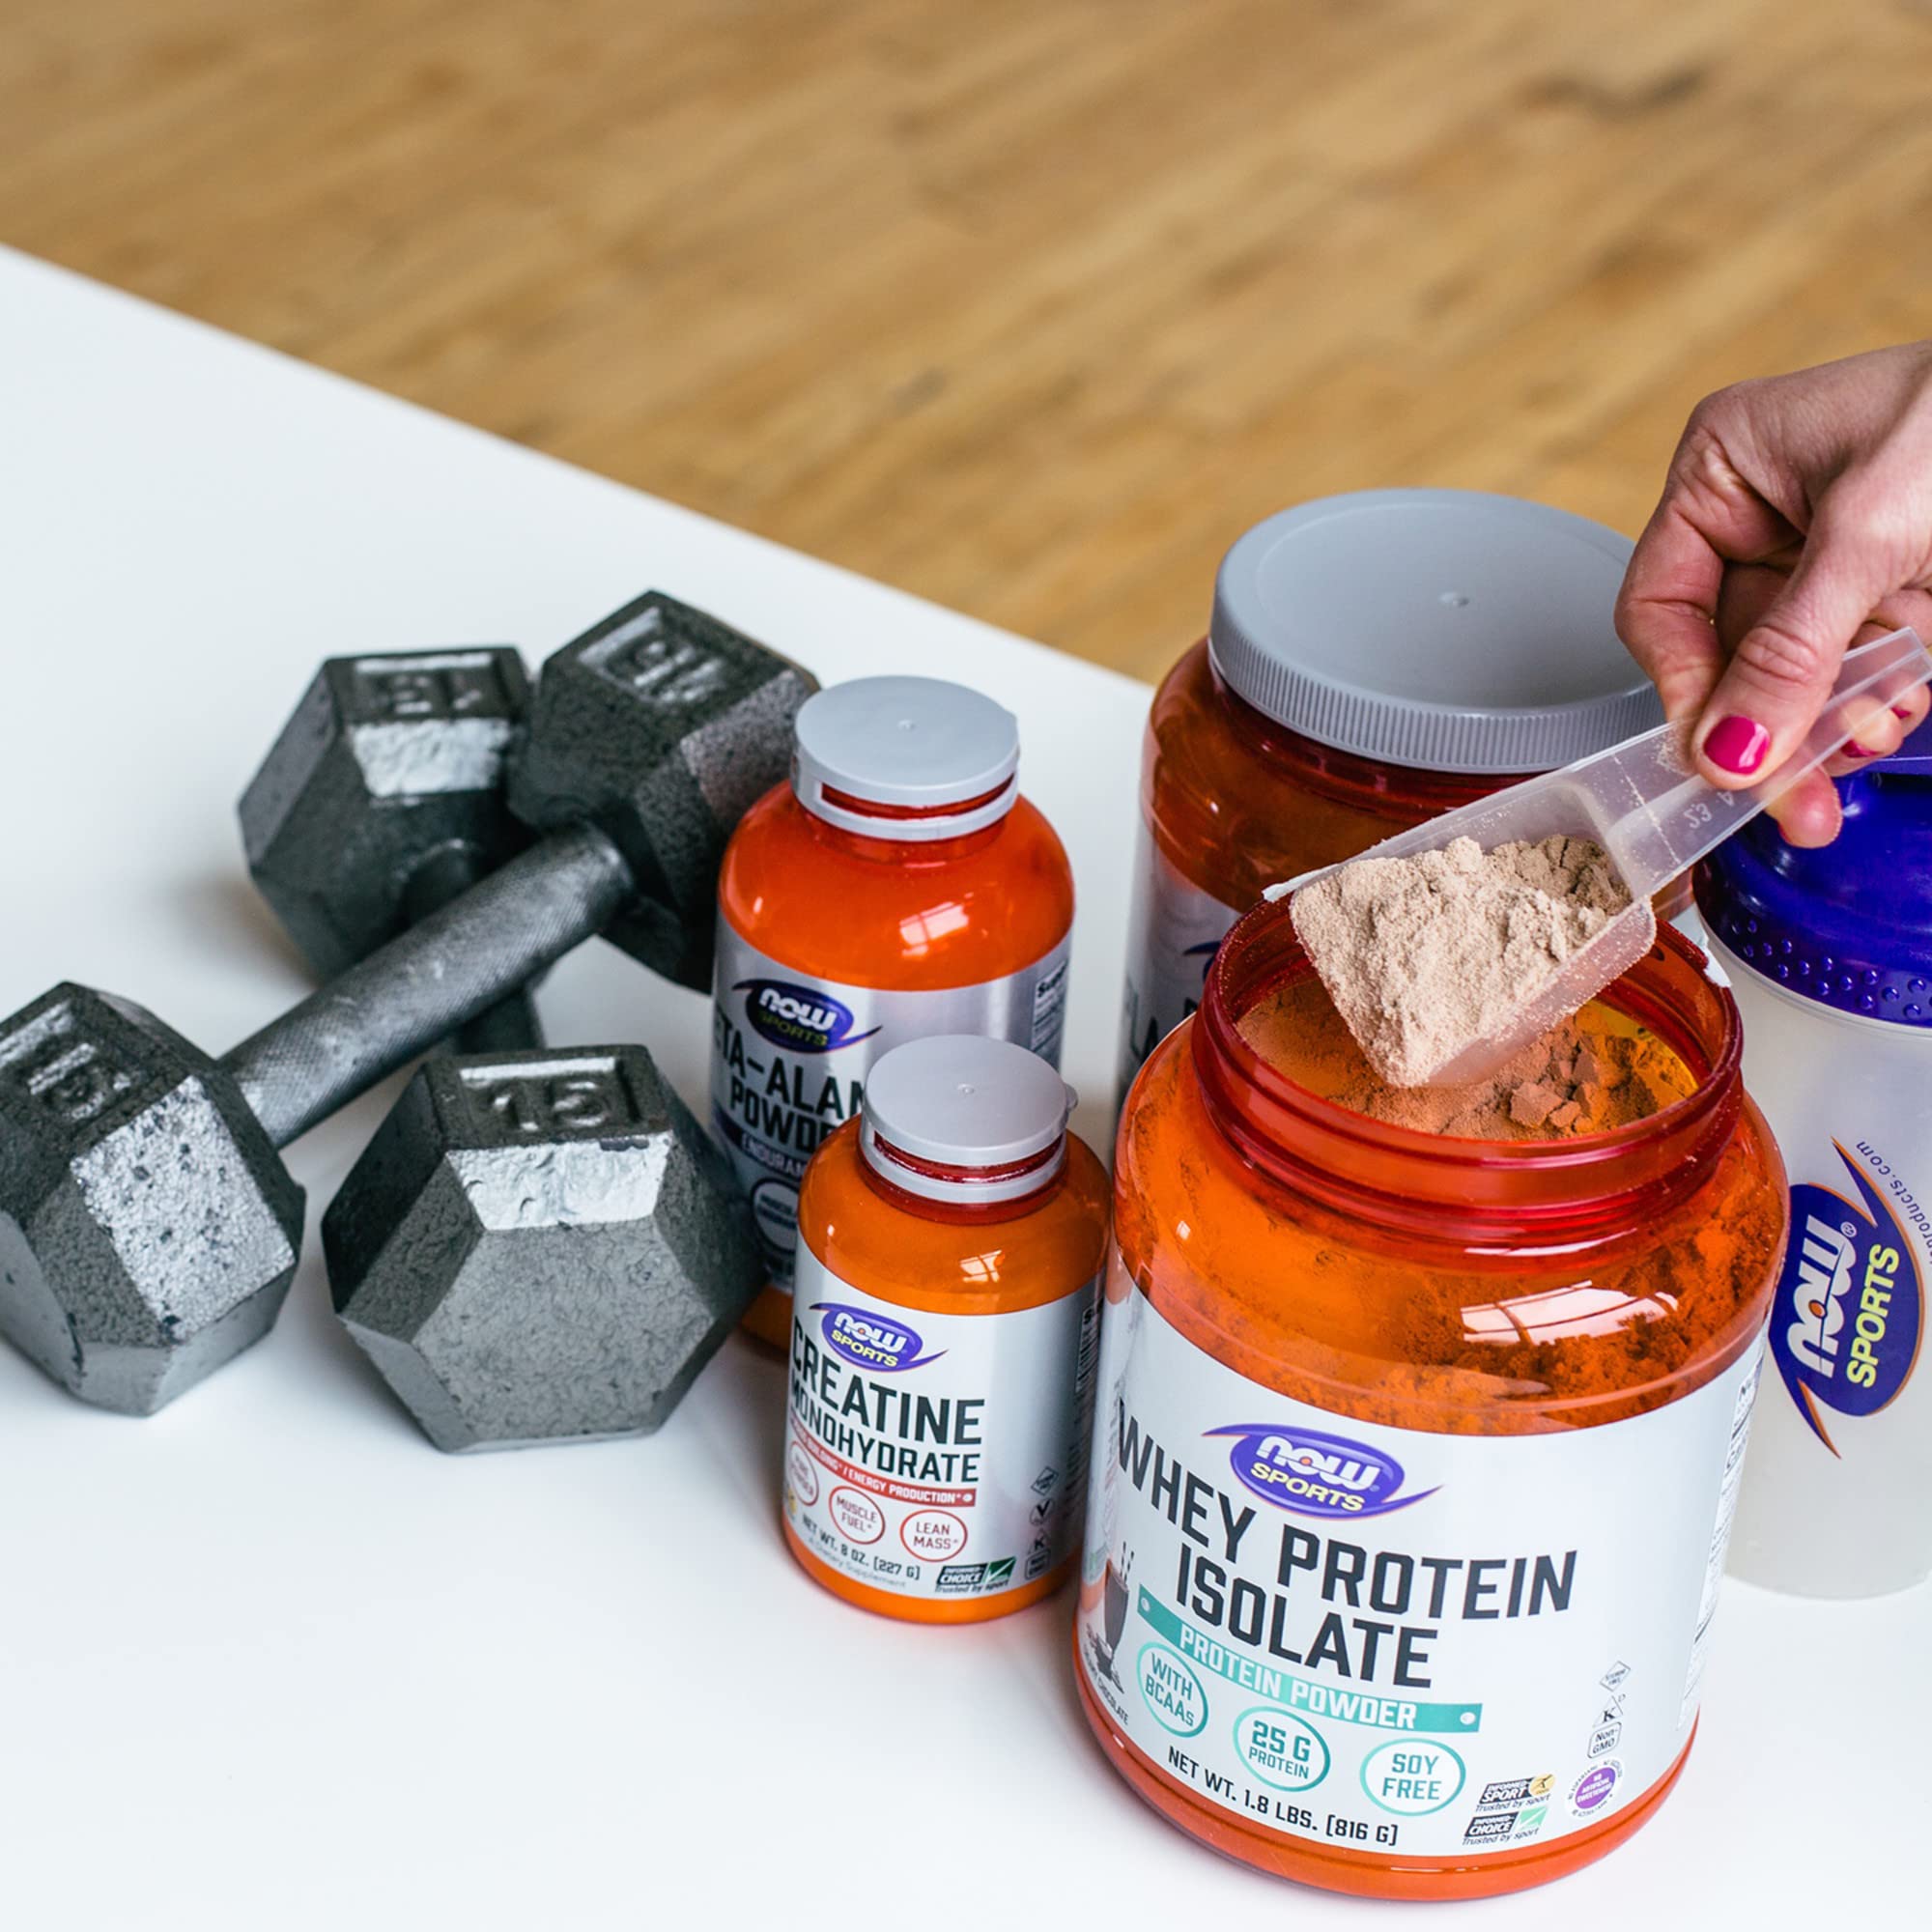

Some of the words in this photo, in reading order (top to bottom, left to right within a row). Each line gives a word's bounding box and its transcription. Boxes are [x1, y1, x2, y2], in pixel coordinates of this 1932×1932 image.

[493, 1080, 612, 1132] 15
[1846, 1243, 1901, 1389] SPORTS
[832, 1328, 899, 1367] SPORTS
[793, 1315, 985, 1446] CREATINE
[790, 1367, 980, 1483] MONOHYDRATE
[1249, 1462, 1366, 1512] SPORTS
[836, 1494, 877, 1523] MUSCLE
[916, 1520, 951, 1536] LEAN
[1119, 1396, 1257, 1565] WHEY
[1276, 1523, 1577, 1621] PROTEIN
[1176, 1542, 1438, 1689] ISOLATE
[1151, 1652, 1193, 1701] WITH
[1179, 1623, 1284, 1698] PROTEIN
[1290, 1679, 1417, 1729] POWDER
[1251, 1719, 1287, 1755] 25
[1293, 1734, 1312, 1762] G
[1591, 1738, 1616, 1754] GMO
[1248, 1746, 1310, 1779] PROTEIN
[1391, 1752, 1440, 1776] SOY
[1168, 1745, 1199, 1779] NET
[1205, 1768, 1237, 1802] WT.
[1243, 1788, 1269, 1814] 1.8
[1274, 1801, 1319, 1832] LBS.
[1381, 1777, 1443, 1801] FREE
[1475, 1801, 1511, 1812] Trusted
[1512, 1798, 1524, 1808] by
[1481, 1787, 1529, 1804] SPORT
[1462, 1833, 1497, 1846] Trusted
[1499, 1832, 1511, 1842] by
[1468, 1821, 1514, 1836] CHOICE
